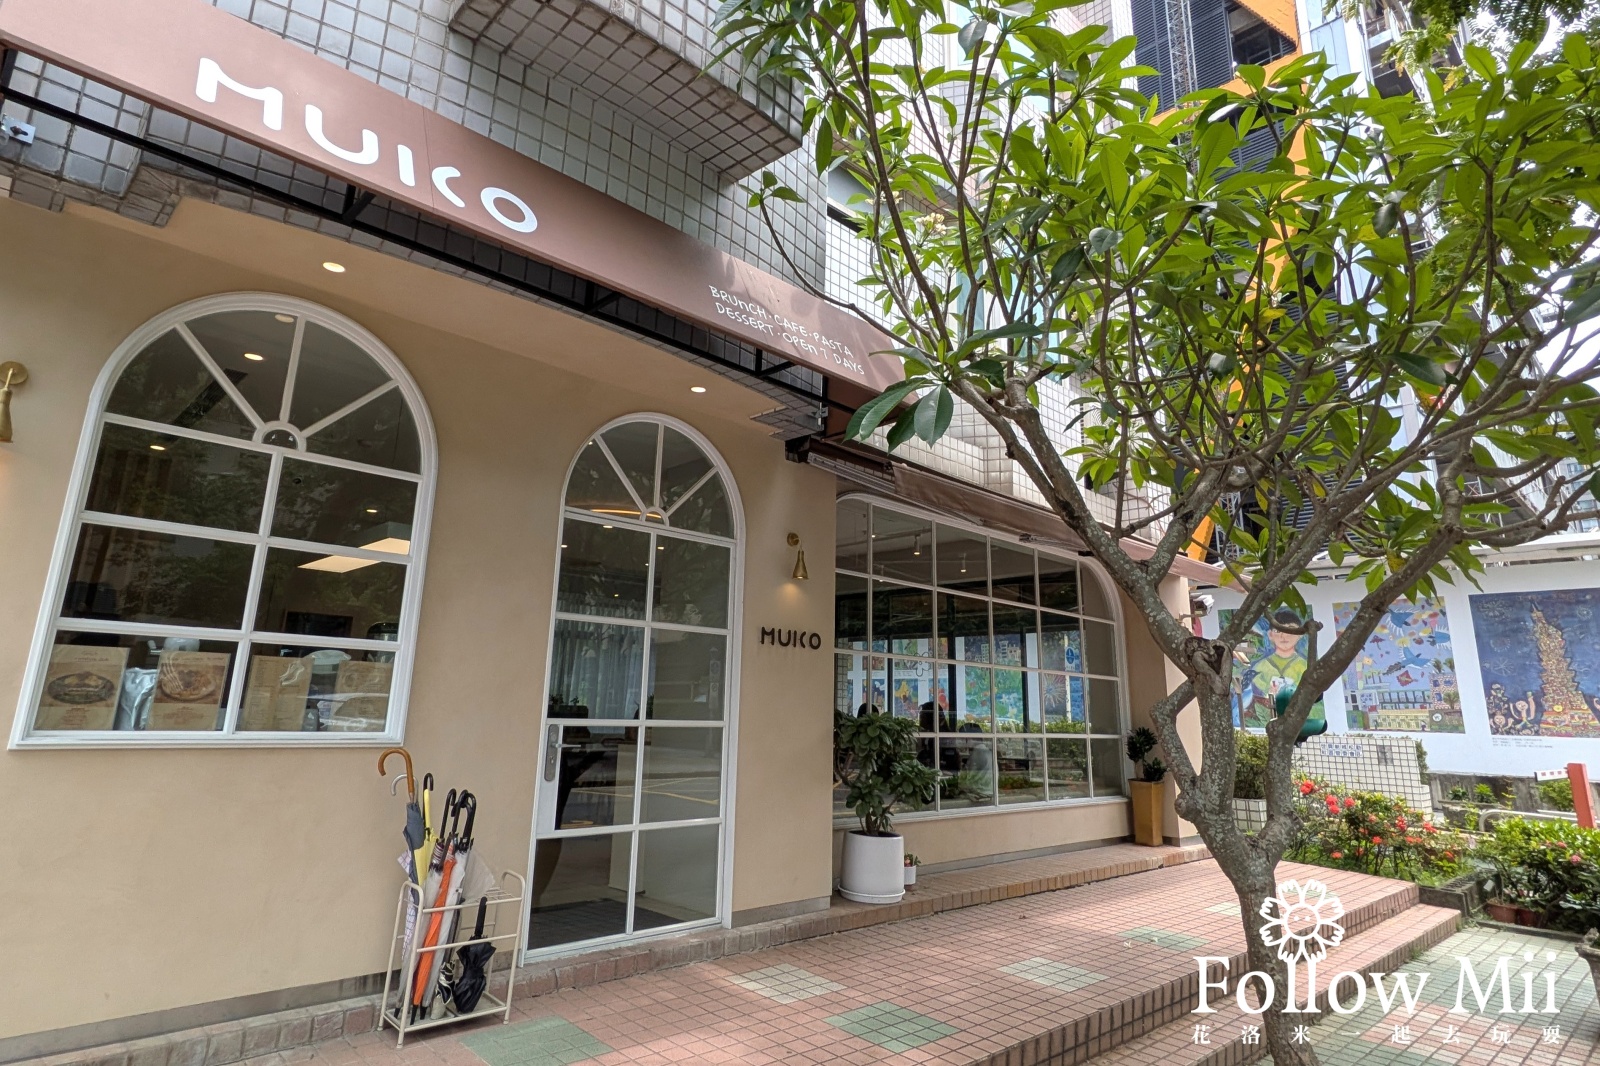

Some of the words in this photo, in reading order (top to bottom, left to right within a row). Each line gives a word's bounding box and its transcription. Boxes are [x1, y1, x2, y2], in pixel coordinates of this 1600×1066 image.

[195, 57, 539, 233] MUICO
[715, 302, 774, 336] DESSERT
[834, 353, 865, 375] DAYS
[774, 314, 808, 337] CAFE
[813, 331, 854, 358] PASTA
[760, 626, 822, 650] MUICO
